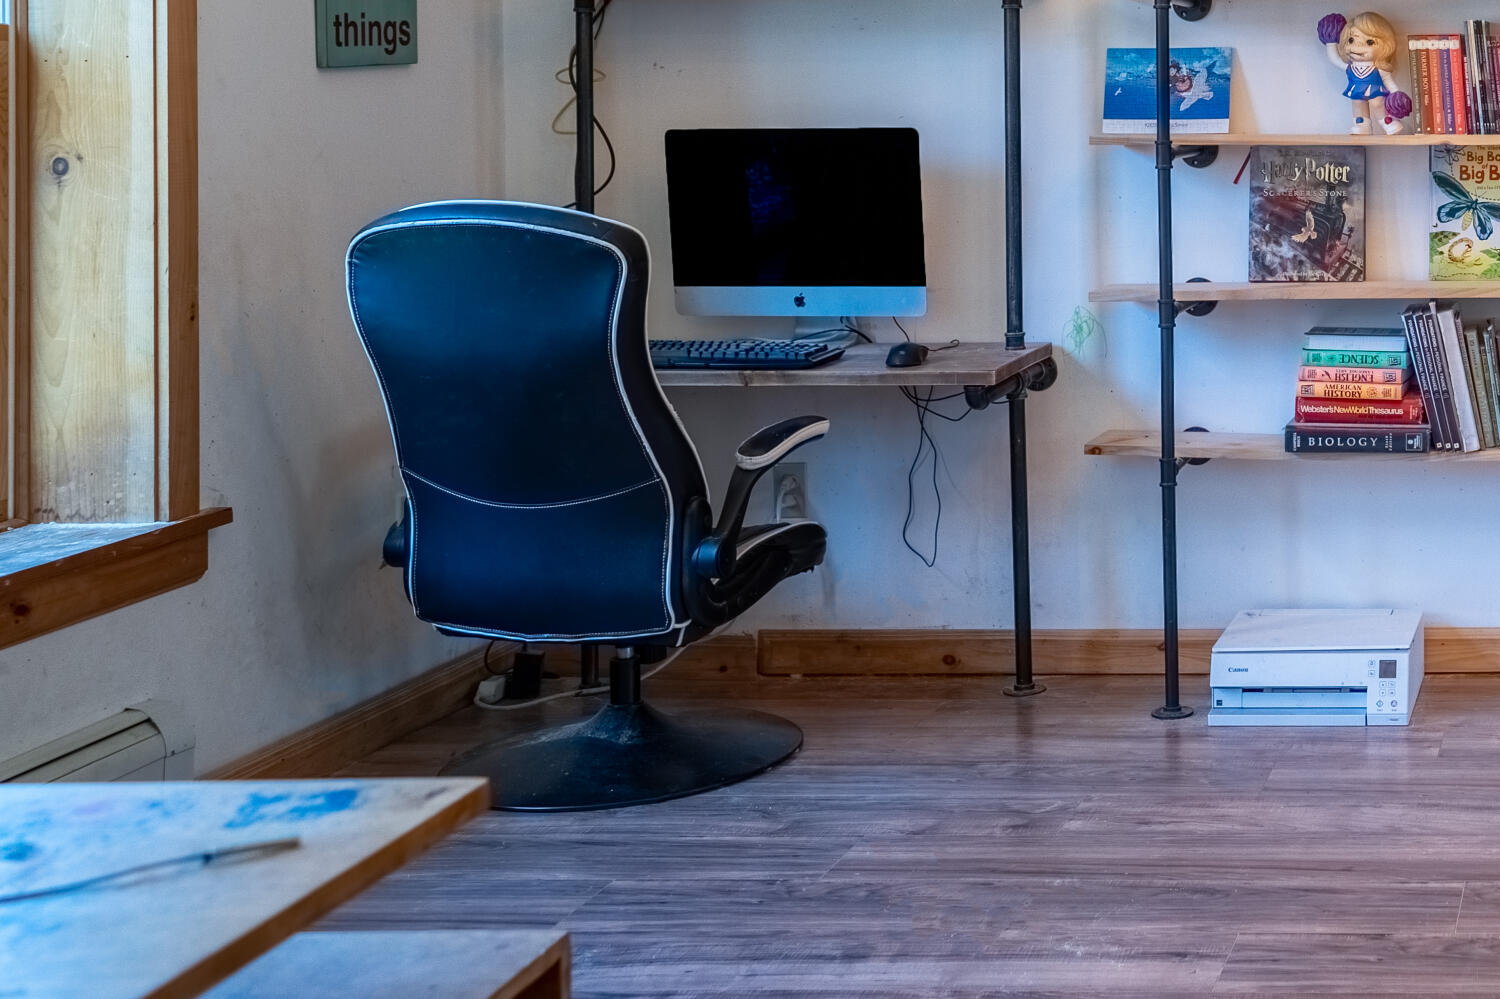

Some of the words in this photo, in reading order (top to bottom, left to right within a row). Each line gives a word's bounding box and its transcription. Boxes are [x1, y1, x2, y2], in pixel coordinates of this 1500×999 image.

[333, 12, 411, 56] things
[1466, 151, 1484, 164] Big
[1305, 157, 1351, 184] Potter
[1459, 164, 1485, 184] Big
[1319, 188, 1348, 197] STONE
[1406, 319, 1419, 348] FOUNDATIONS
[1426, 319, 1438, 348] FOUNDATIONS
[1339, 353, 1380, 365] SCIENCE
[1414, 351, 1425, 374] PERSONAL
[1417, 319, 1429, 348] FOUNDATIONS
[1429, 373, 1439, 392] FINANCE
[1433, 350, 1444, 373] PERSONAL
[1323, 383, 1362, 391] AMERICAN
[1334, 373, 1374, 383] ENGLISH
[1419, 372, 1429, 391] FINANCE
[1438, 372, 1448, 391] FINANCE
[1323, 390, 1363, 399] HISTORY
[1300, 405, 1334, 414] Webster's
[1334, 406, 1349, 414] New
[1348, 406, 1369, 414] World
[1368, 406, 1404, 415] Thesaurus
[1308, 436, 1378, 447] BIOLOGY
